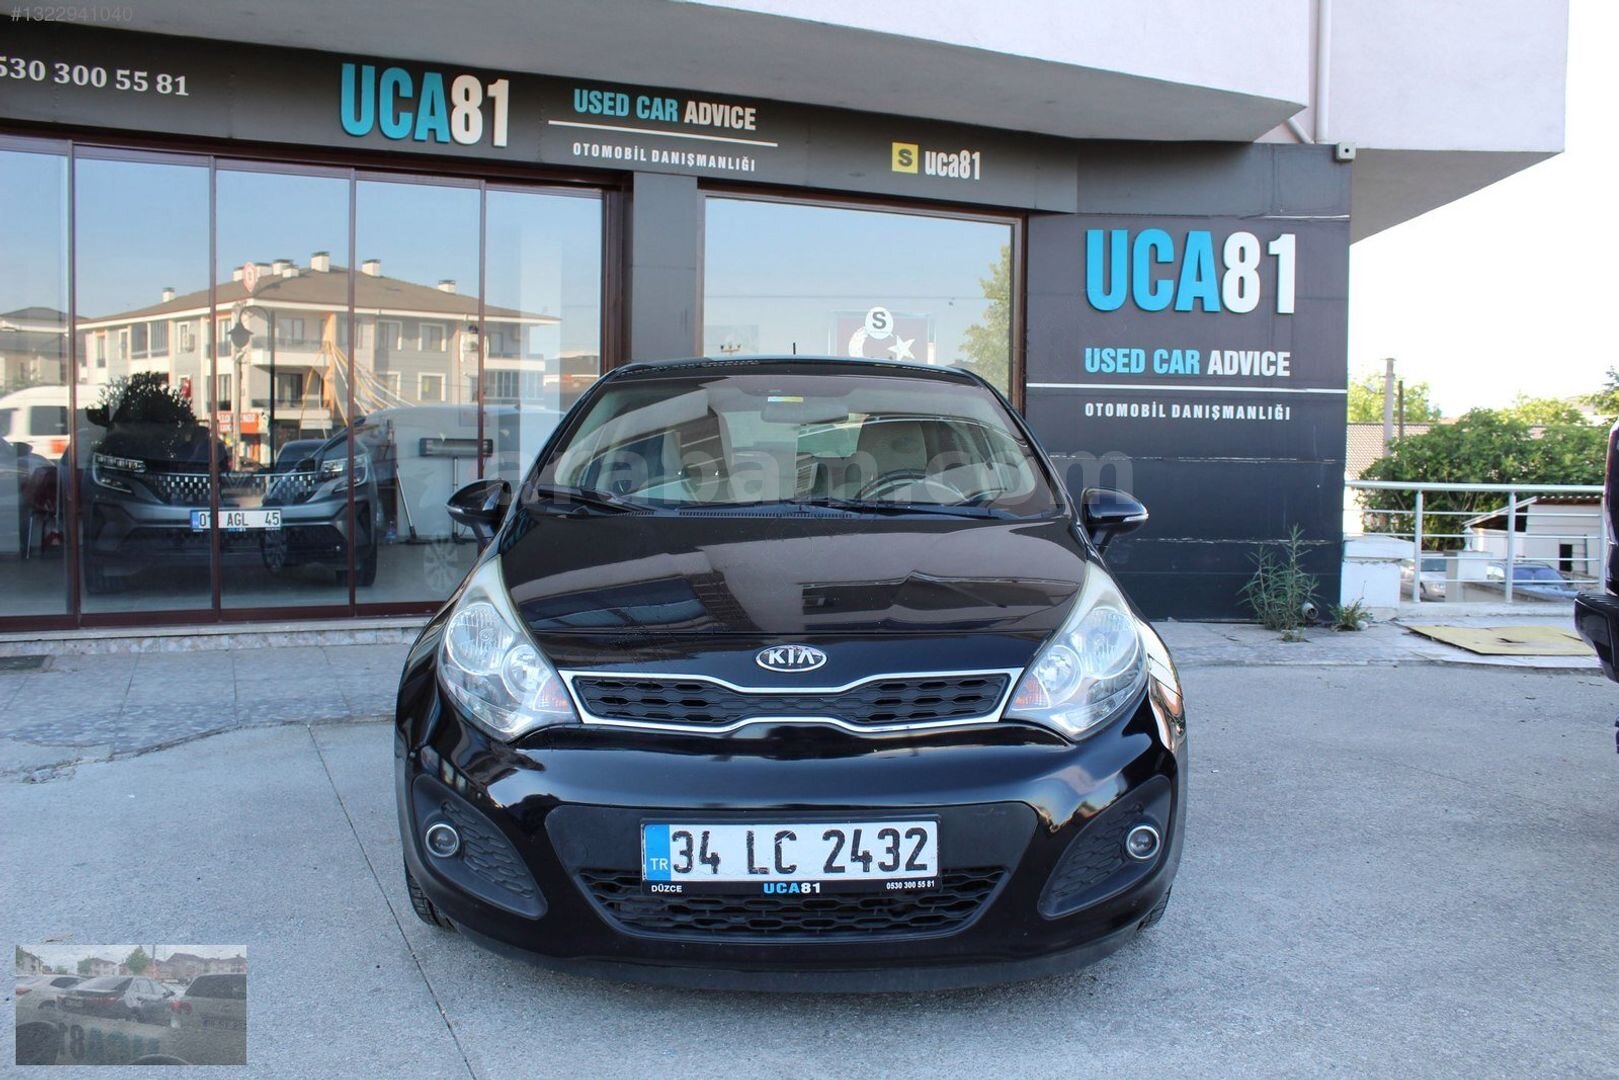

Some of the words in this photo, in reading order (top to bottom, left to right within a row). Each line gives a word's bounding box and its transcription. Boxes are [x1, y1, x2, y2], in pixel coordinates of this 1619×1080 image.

[53, 63, 108, 88] 300
[115, 69, 149, 93] 55
[156, 73, 190, 97] 81
[340, 63, 509, 147] UCA81
[573, 88, 630, 116] USED
[636, 95, 679, 123] CAR
[684, 101, 757, 131] ADVICE
[573, 141, 648, 163] OTOMOBİL
[651, 148, 756, 173] DANIŞMANLIĞI
[925, 150, 981, 180] uca81
[1085, 228, 1296, 314] UCA81
[1085, 348, 1145, 374] USED
[1153, 349, 1200, 375] CAR
[1207, 350, 1290, 377] ADVICE
[1085, 402, 1166, 418] OTOMOBİL
[1172, 403, 1291, 421] DANIŞMANLIĞI
[227, 512, 248, 526] AGL
[265, 512, 279, 526] 45
[768, 648, 815, 665] KIA
[650, 858, 669, 871] TR
[672, 830, 721, 875] 34
[746, 830, 797, 875] LC
[823, 827, 928, 874] 2432
[763, 882, 821, 894] UCA81
[904, 880, 917, 889] 300
